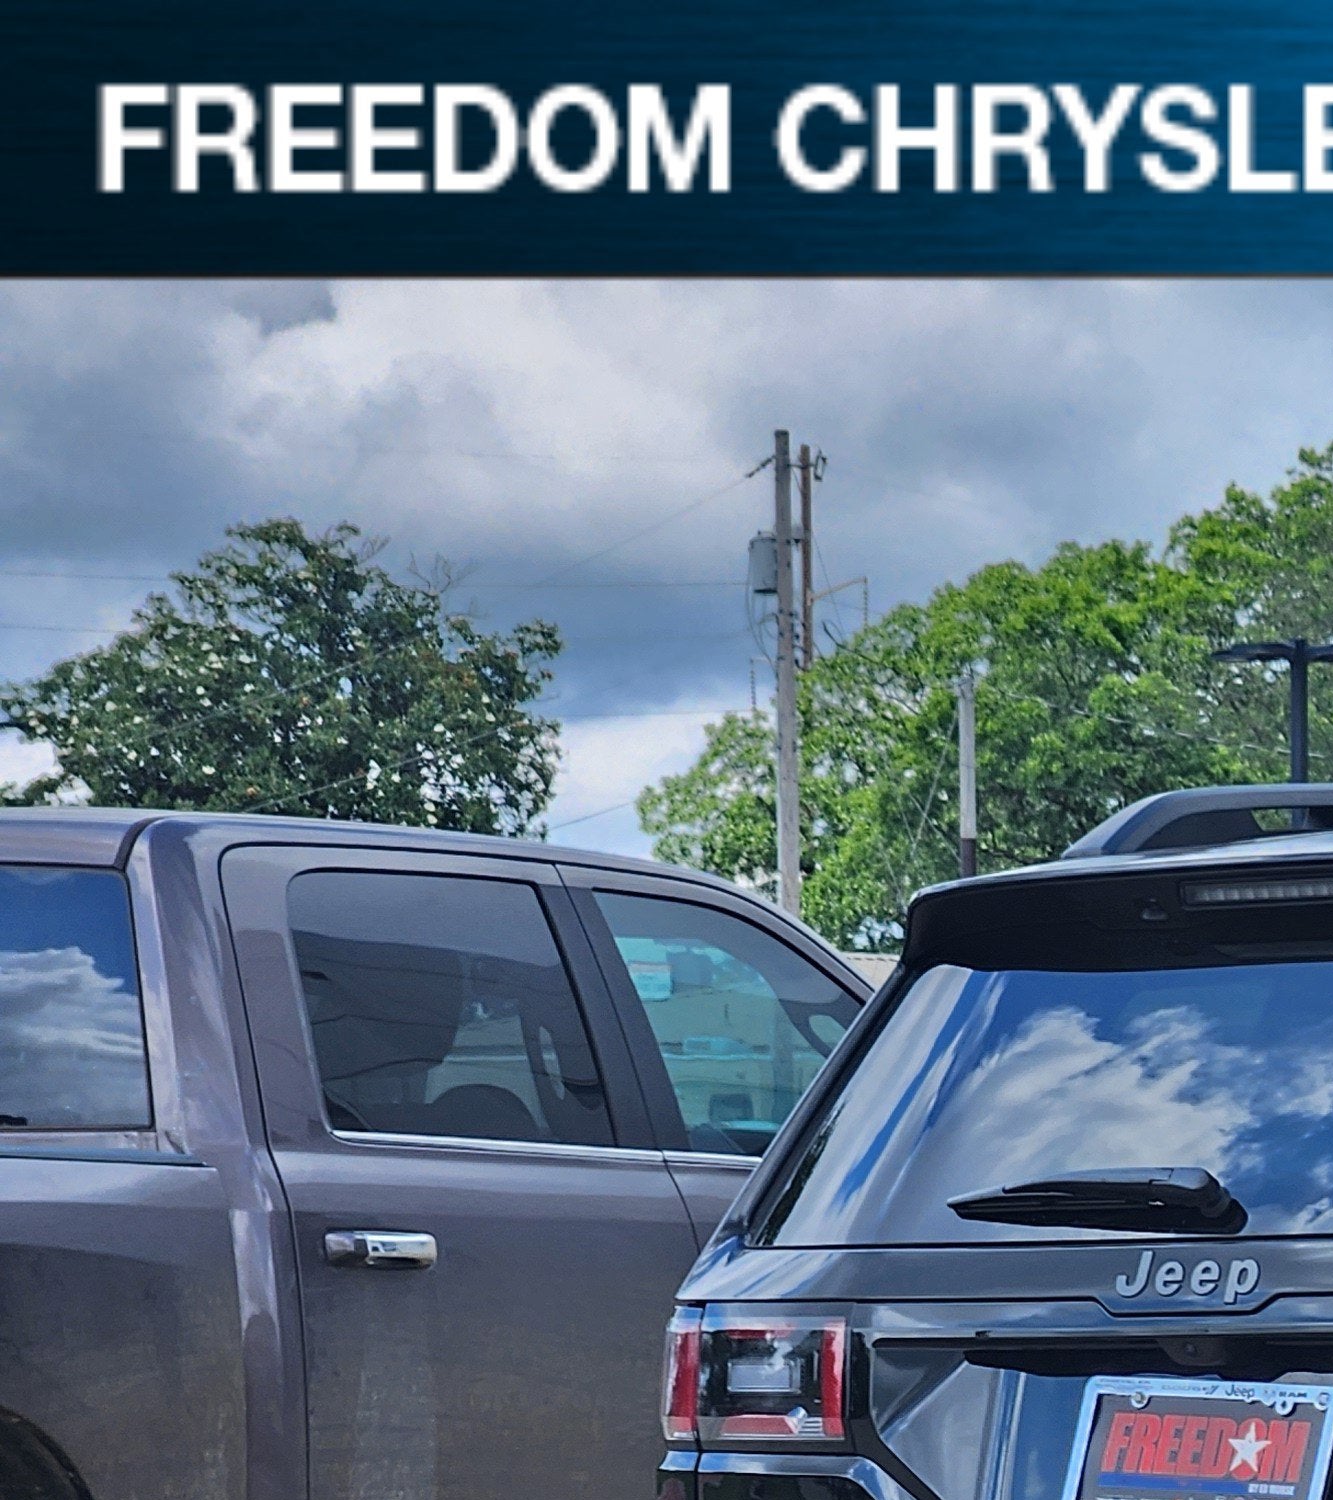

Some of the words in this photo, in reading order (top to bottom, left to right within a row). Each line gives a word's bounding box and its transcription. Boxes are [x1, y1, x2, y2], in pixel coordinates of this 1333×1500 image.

[1115, 1249, 1260, 1305] Jeep
[1224, 1383, 1255, 1399] Jeep
[1101, 1412, 1312, 1483] FREEDOM
